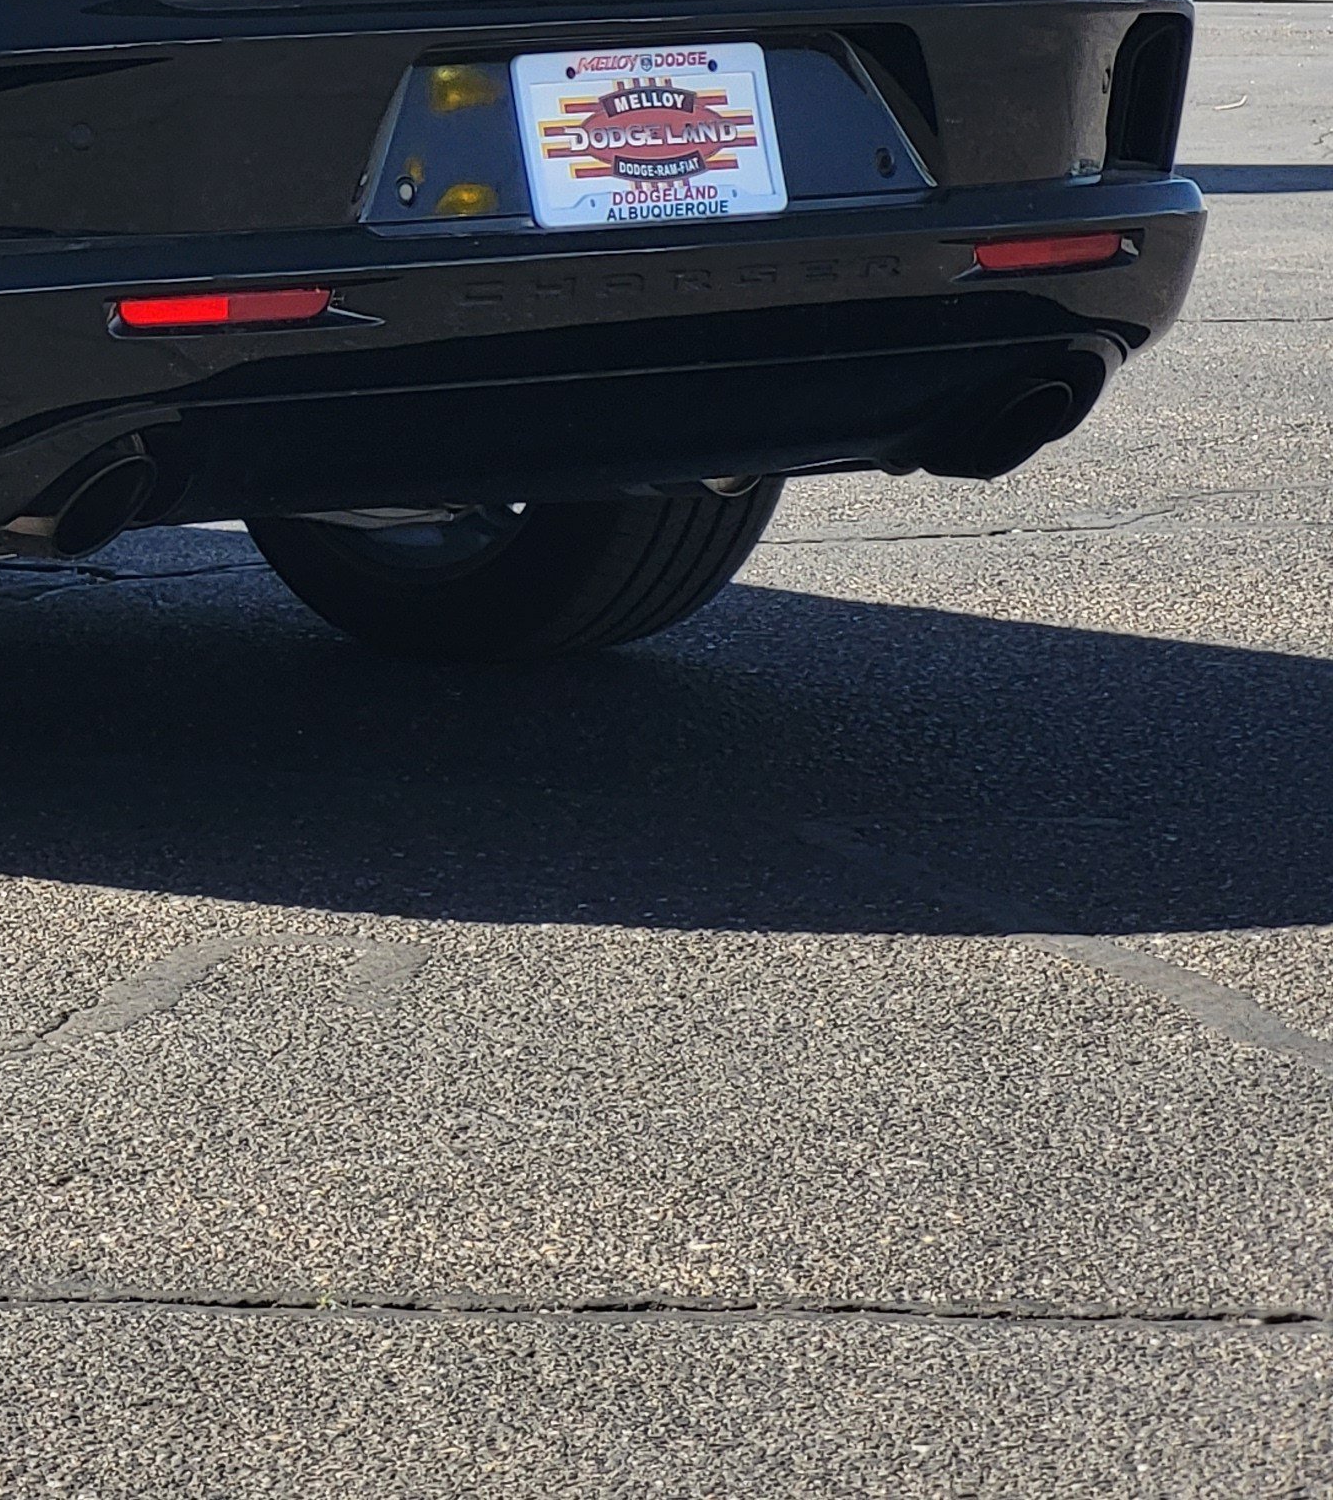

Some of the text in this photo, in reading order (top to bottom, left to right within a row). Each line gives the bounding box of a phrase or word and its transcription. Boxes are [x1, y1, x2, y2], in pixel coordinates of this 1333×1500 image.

[575, 51, 708, 74] MELLOY DODGE
[614, 91, 686, 113] MELLOY
[612, 185, 719, 206] DODGELAND
[606, 200, 729, 222] ALBUQUERQUE
